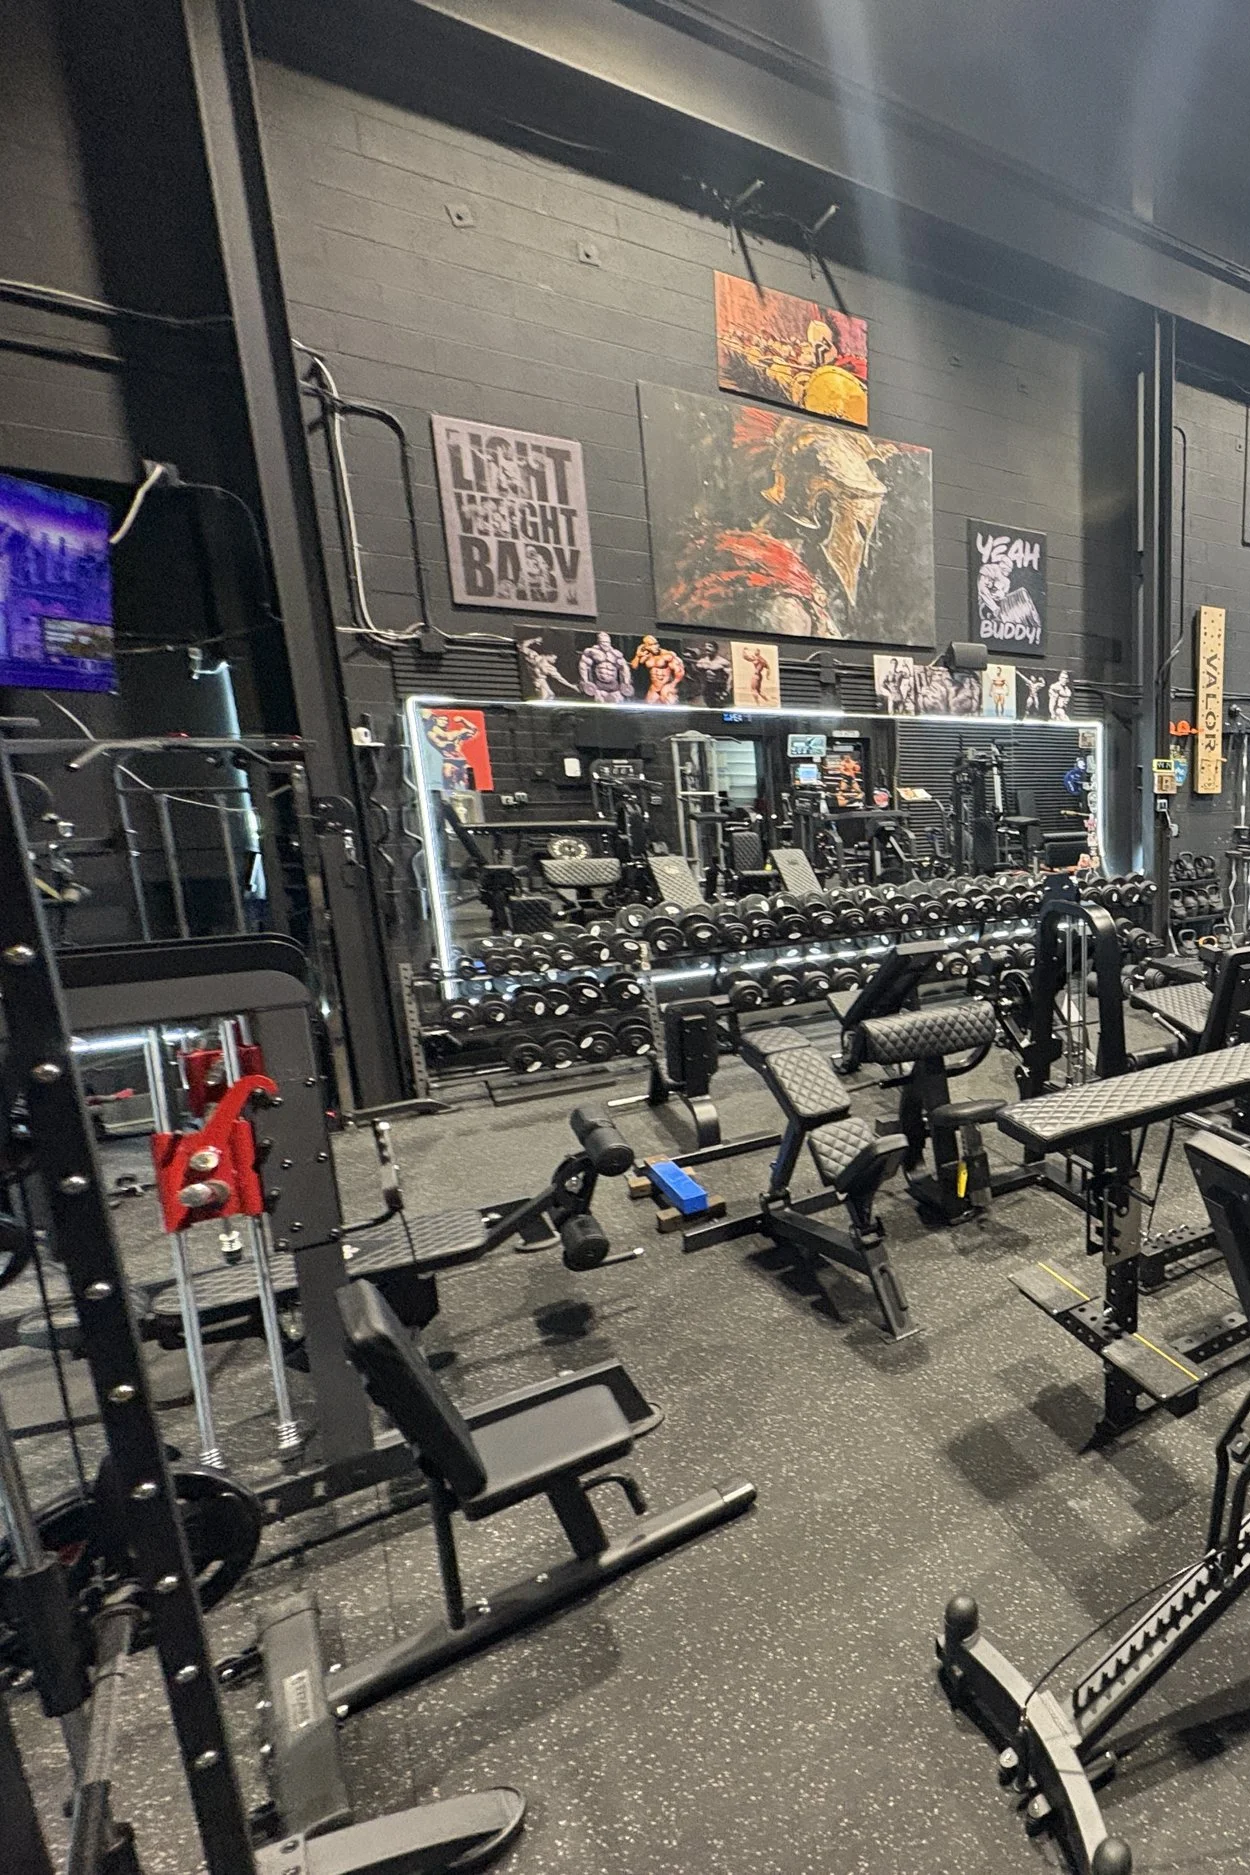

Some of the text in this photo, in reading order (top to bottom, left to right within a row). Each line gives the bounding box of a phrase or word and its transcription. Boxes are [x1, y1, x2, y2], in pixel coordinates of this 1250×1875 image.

[445, 428, 573, 506] LIGHT
[459, 534, 581, 606] BABY
[976, 532, 1040, 570] YEAH
[980, 619, 1042, 645] BUDDY!
[1203, 653, 1218, 752] VALOR
